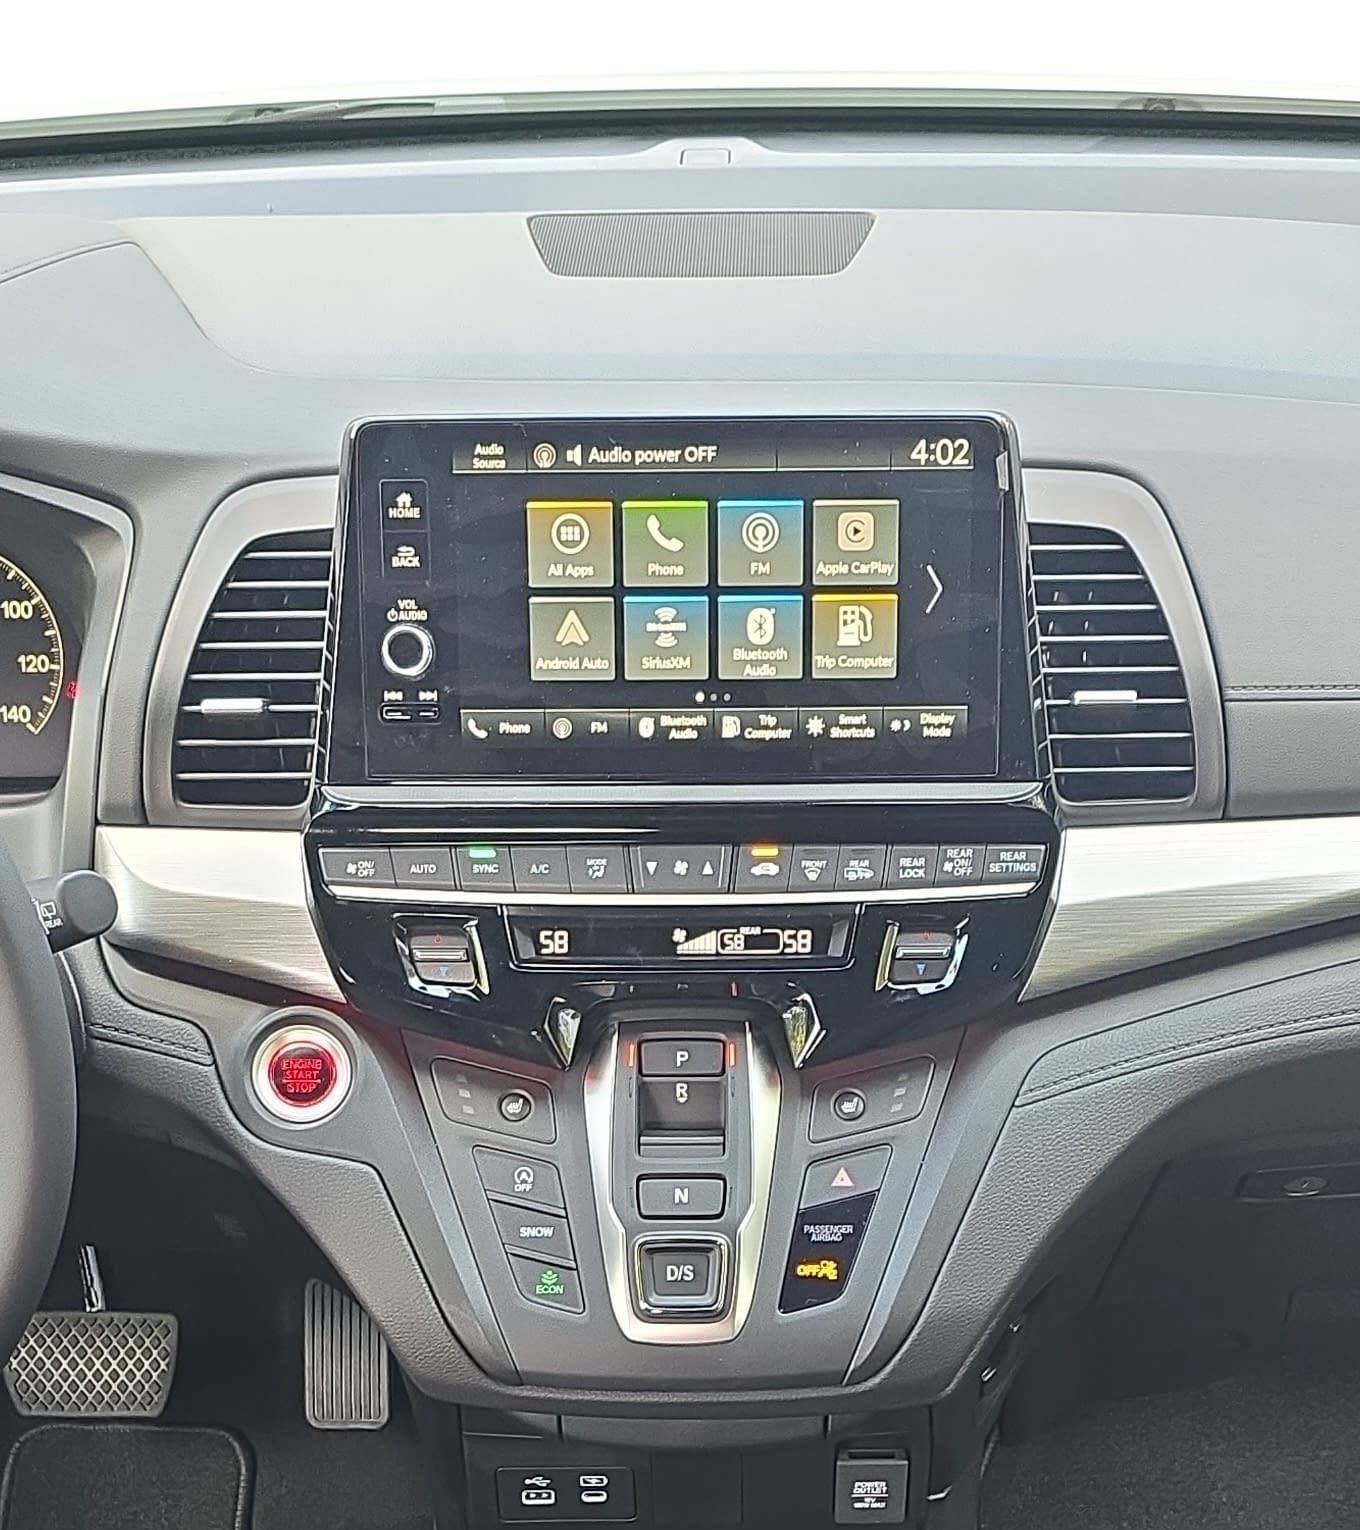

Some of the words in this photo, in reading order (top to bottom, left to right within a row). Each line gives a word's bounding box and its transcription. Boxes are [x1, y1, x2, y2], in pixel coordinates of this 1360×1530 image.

[474, 443, 504, 457] Audio
[588, 447, 632, 463] Audio
[635, 449, 681, 466] power
[684, 445, 718, 462] OFF
[910, 438, 970, 465] 4:02
[472, 458, 506, 469] Source
[388, 507, 421, 519] HOME
[392, 556, 420, 568] BACK
[548, 563, 566, 576] All
[569, 563, 595, 578] Apps
[648, 563, 684, 576] Phone
[750, 562, 771, 576] FM
[816, 562, 850, 578] Apple
[851, 561, 895, 578] CarPlay
[0, 600, 33, 619] 100
[398, 599, 418, 610] VOL
[398, 610, 428, 622] AUDIO
[733, 648, 788, 662] Bluetooth
[17, 654, 50, 673] 120
[536, 656, 581, 670] Android
[582, 657, 610, 670] Auto
[641, 656, 691, 670] SiriusXM
[815, 656, 835, 671] Trip
[837, 655, 895, 671] Computer
[743, 664, 777, 677] Audio
[0, 705, 31, 724] 140
[758, 714, 777, 727] Trip
[838, 713, 867, 726] Smart
[919, 712, 955, 726] Display
[499, 721, 531, 735] Phone
[591, 722, 608, 734] FM
[660, 715, 707, 728] Bluetooth
[668, 727, 699, 740] Audio
[744, 727, 792, 740] Computer
[829, 726, 876, 739] Shortcuts
[923, 726, 951, 738] Mode
[946, 848, 973, 859] REAR
[1000, 851, 1027, 861] REAR
[410, 863, 436, 874] AUTO
[472, 863, 499, 874] SYNC
[530, 863, 550, 874] A/C
[586, 858, 608, 867] MODE
[801, 860, 827, 869] FRONT
[849, 860, 870, 869] REAR
[899, 857, 926, 868] REAR
[953, 858, 973, 868] ON/
[989, 861, 1037, 874] SETTINGS
[357, 868, 376, 878] OFF
[899, 868, 926, 879] LOCK
[953, 866, 973, 876] OFF
[739, 926, 761, 936] REAR
[539, 930, 569, 954] 58
[723, 934, 745, 950] 58
[783, 929, 812, 954] 58
[282, 1059, 322, 1069] ENGINE
[676, 1051, 689, 1067] P
[285, 1070, 320, 1079] START
[287, 1083, 317, 1093] STOP
[676, 1083, 688, 1098] R
[514, 1183, 533, 1192] OFF
[674, 1188, 689, 1204] N
[519, 1227, 554, 1238] SNOW
[803, 1225, 853, 1234] PASSENGER
[810, 1233, 842, 1242] AIRBAG
[666, 1265, 694, 1282] D/S
[796, 1264, 821, 1277] OFF
[535, 1284, 564, 1294] ECON
